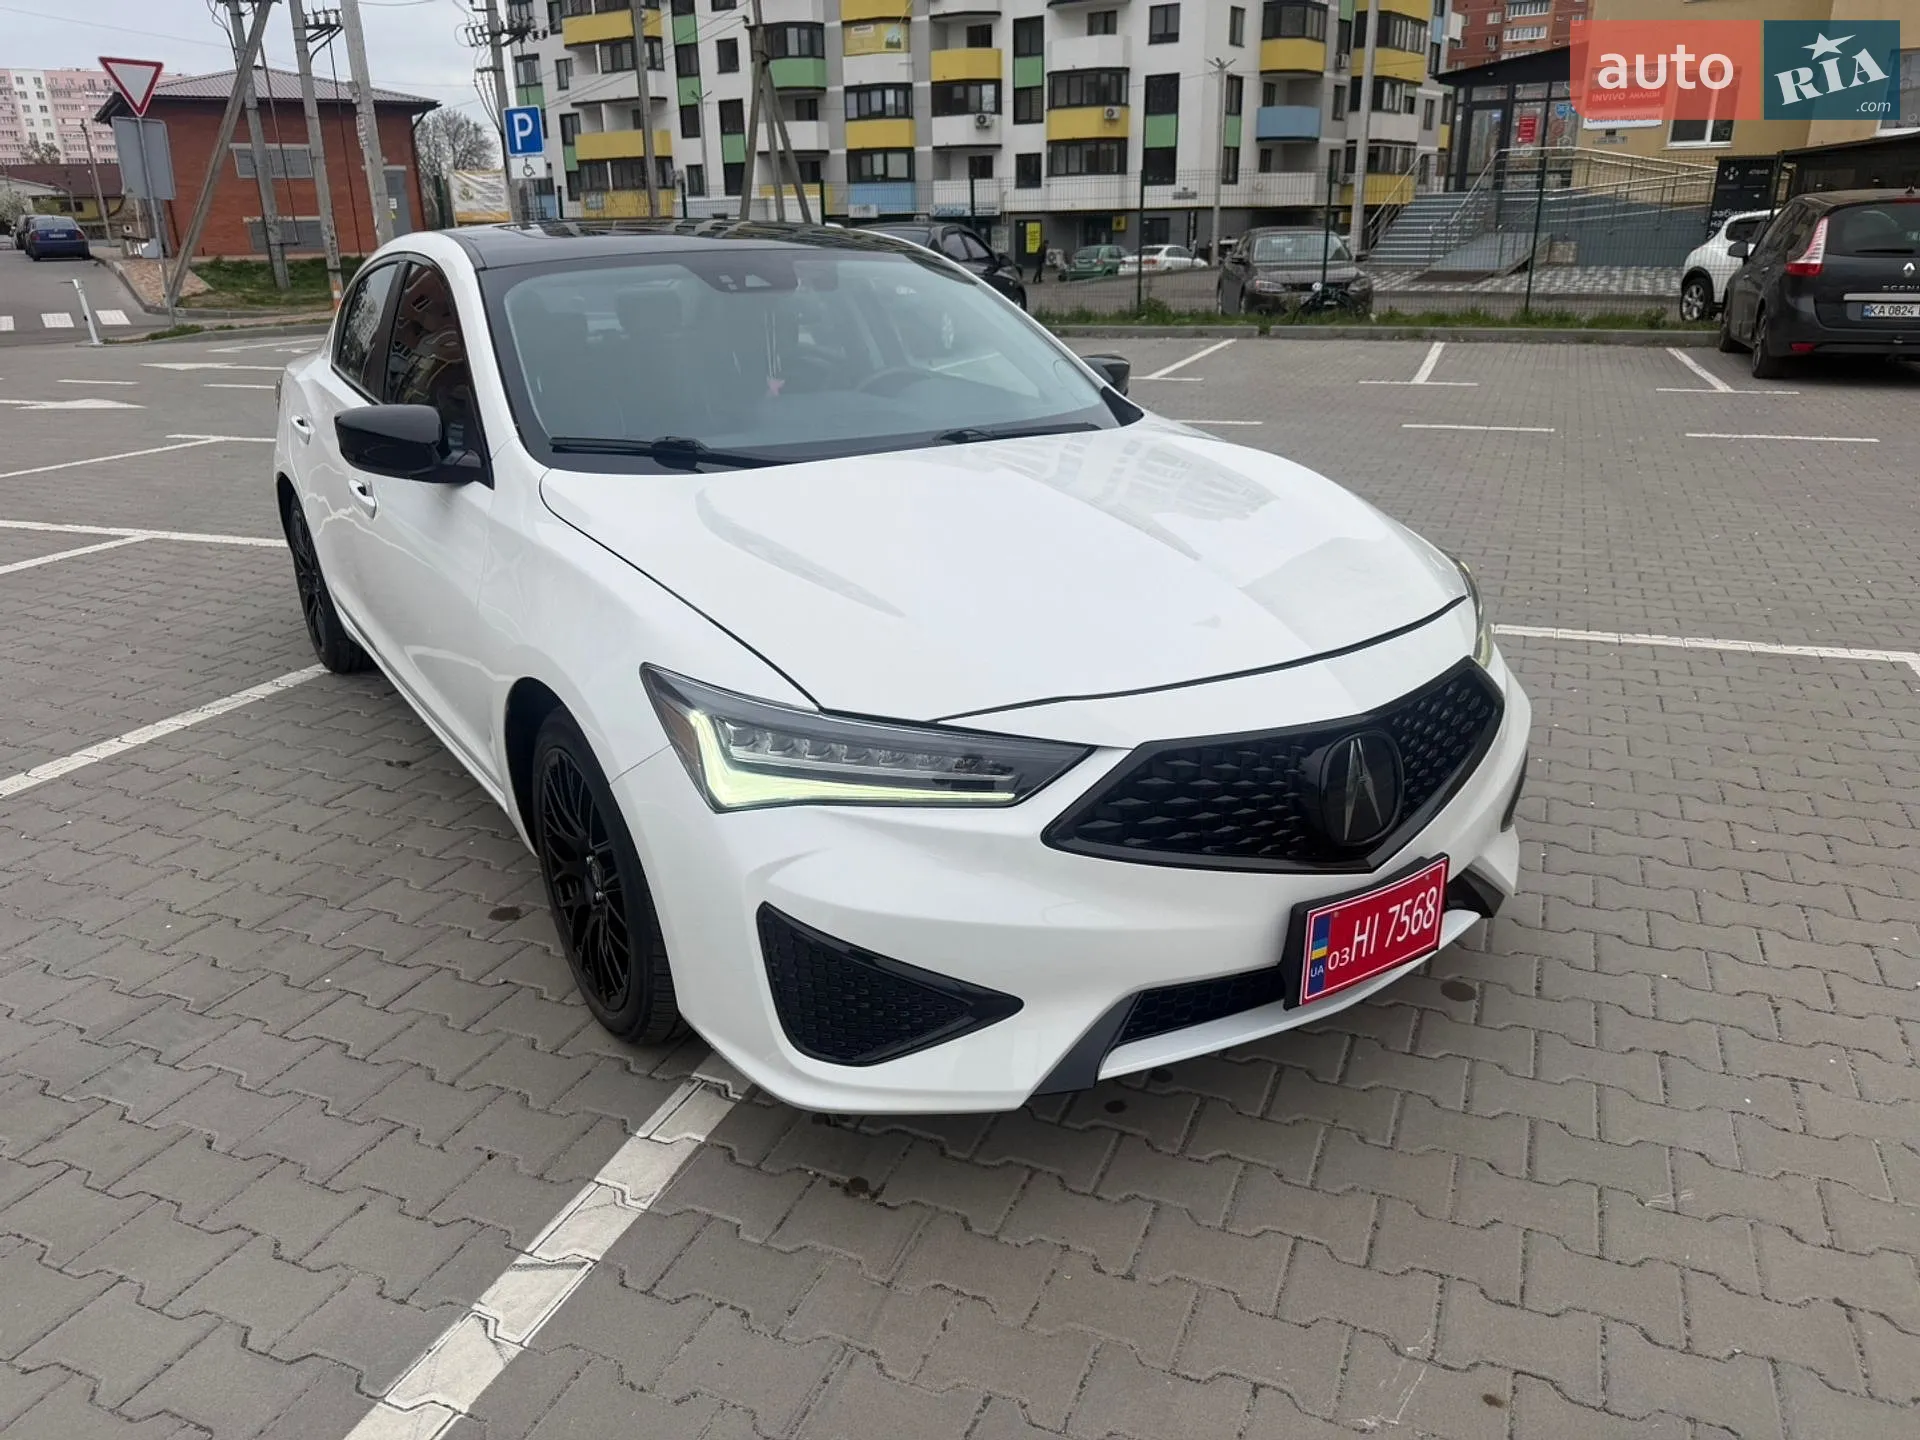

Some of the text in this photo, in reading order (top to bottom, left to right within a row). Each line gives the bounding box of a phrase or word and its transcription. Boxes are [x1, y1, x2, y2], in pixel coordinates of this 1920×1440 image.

[511, 112, 534, 151] P
[1870, 305, 1885, 316] KA
[1385, 886, 1438, 948] 7568
[1310, 965, 1324, 978] UA
